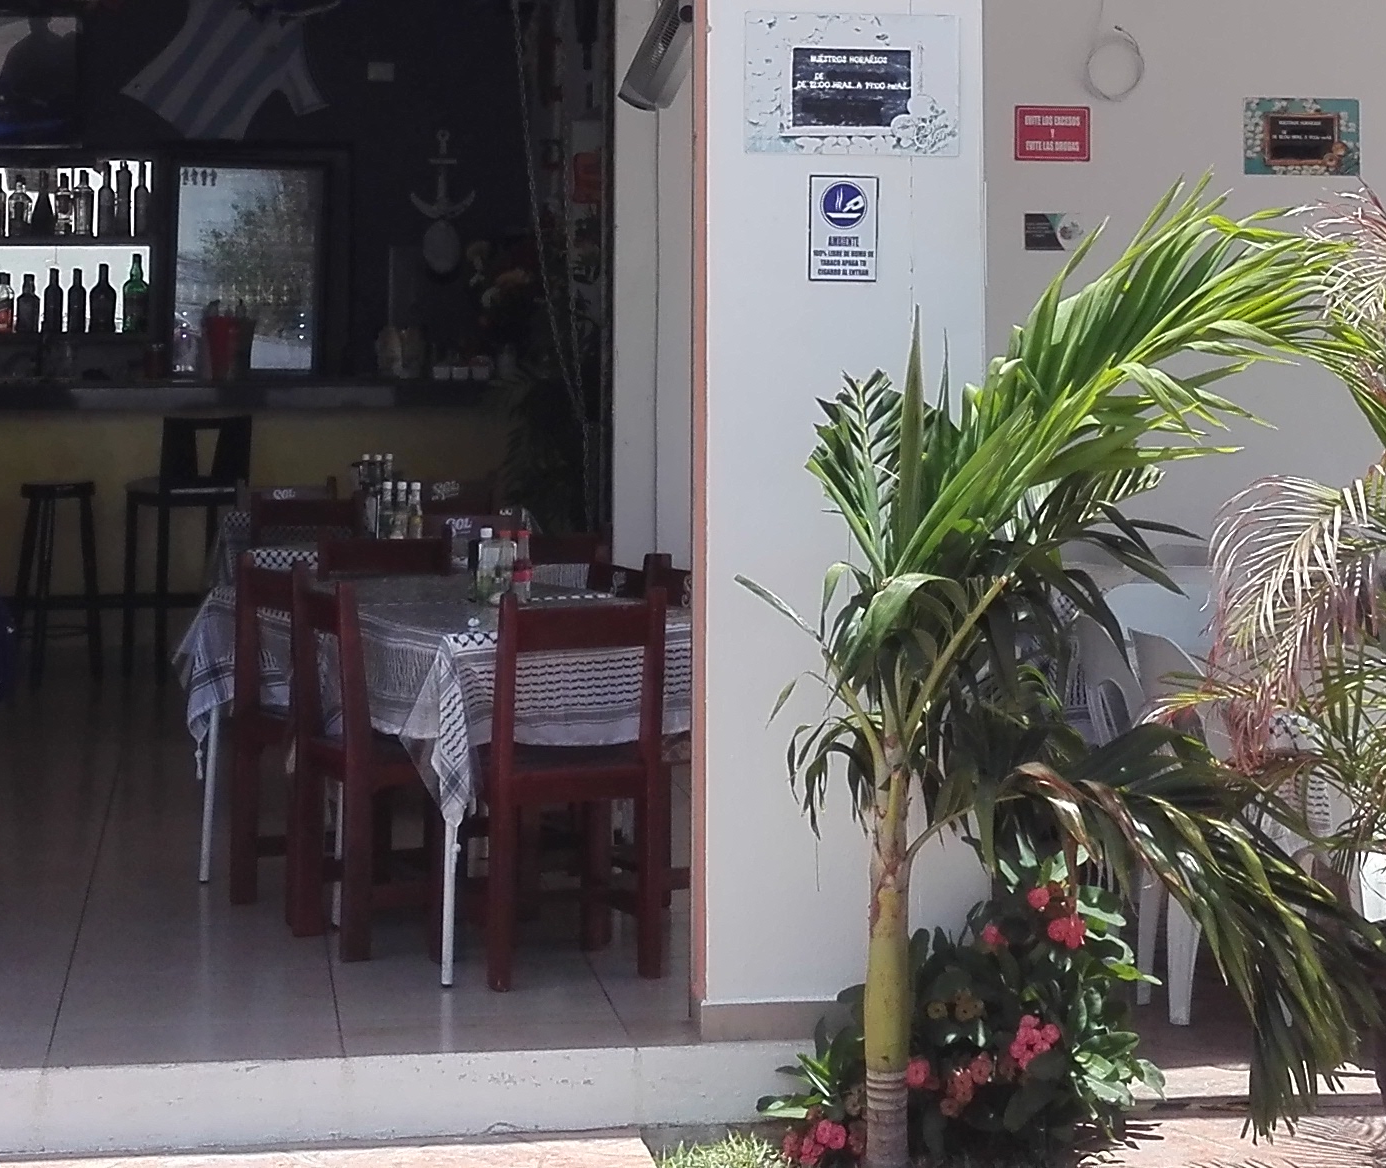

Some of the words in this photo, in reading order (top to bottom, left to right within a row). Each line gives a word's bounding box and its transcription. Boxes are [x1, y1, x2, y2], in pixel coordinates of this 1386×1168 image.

[1024, 115, 1041, 126] EVITE
[1041, 115, 1053, 126] LOS
[1054, 116, 1080, 126] EXCESOS
[1025, 140, 1042, 151] EVITE
[1043, 141, 1053, 151] LAS
[828, 236, 859, 247] AMBIENTE
